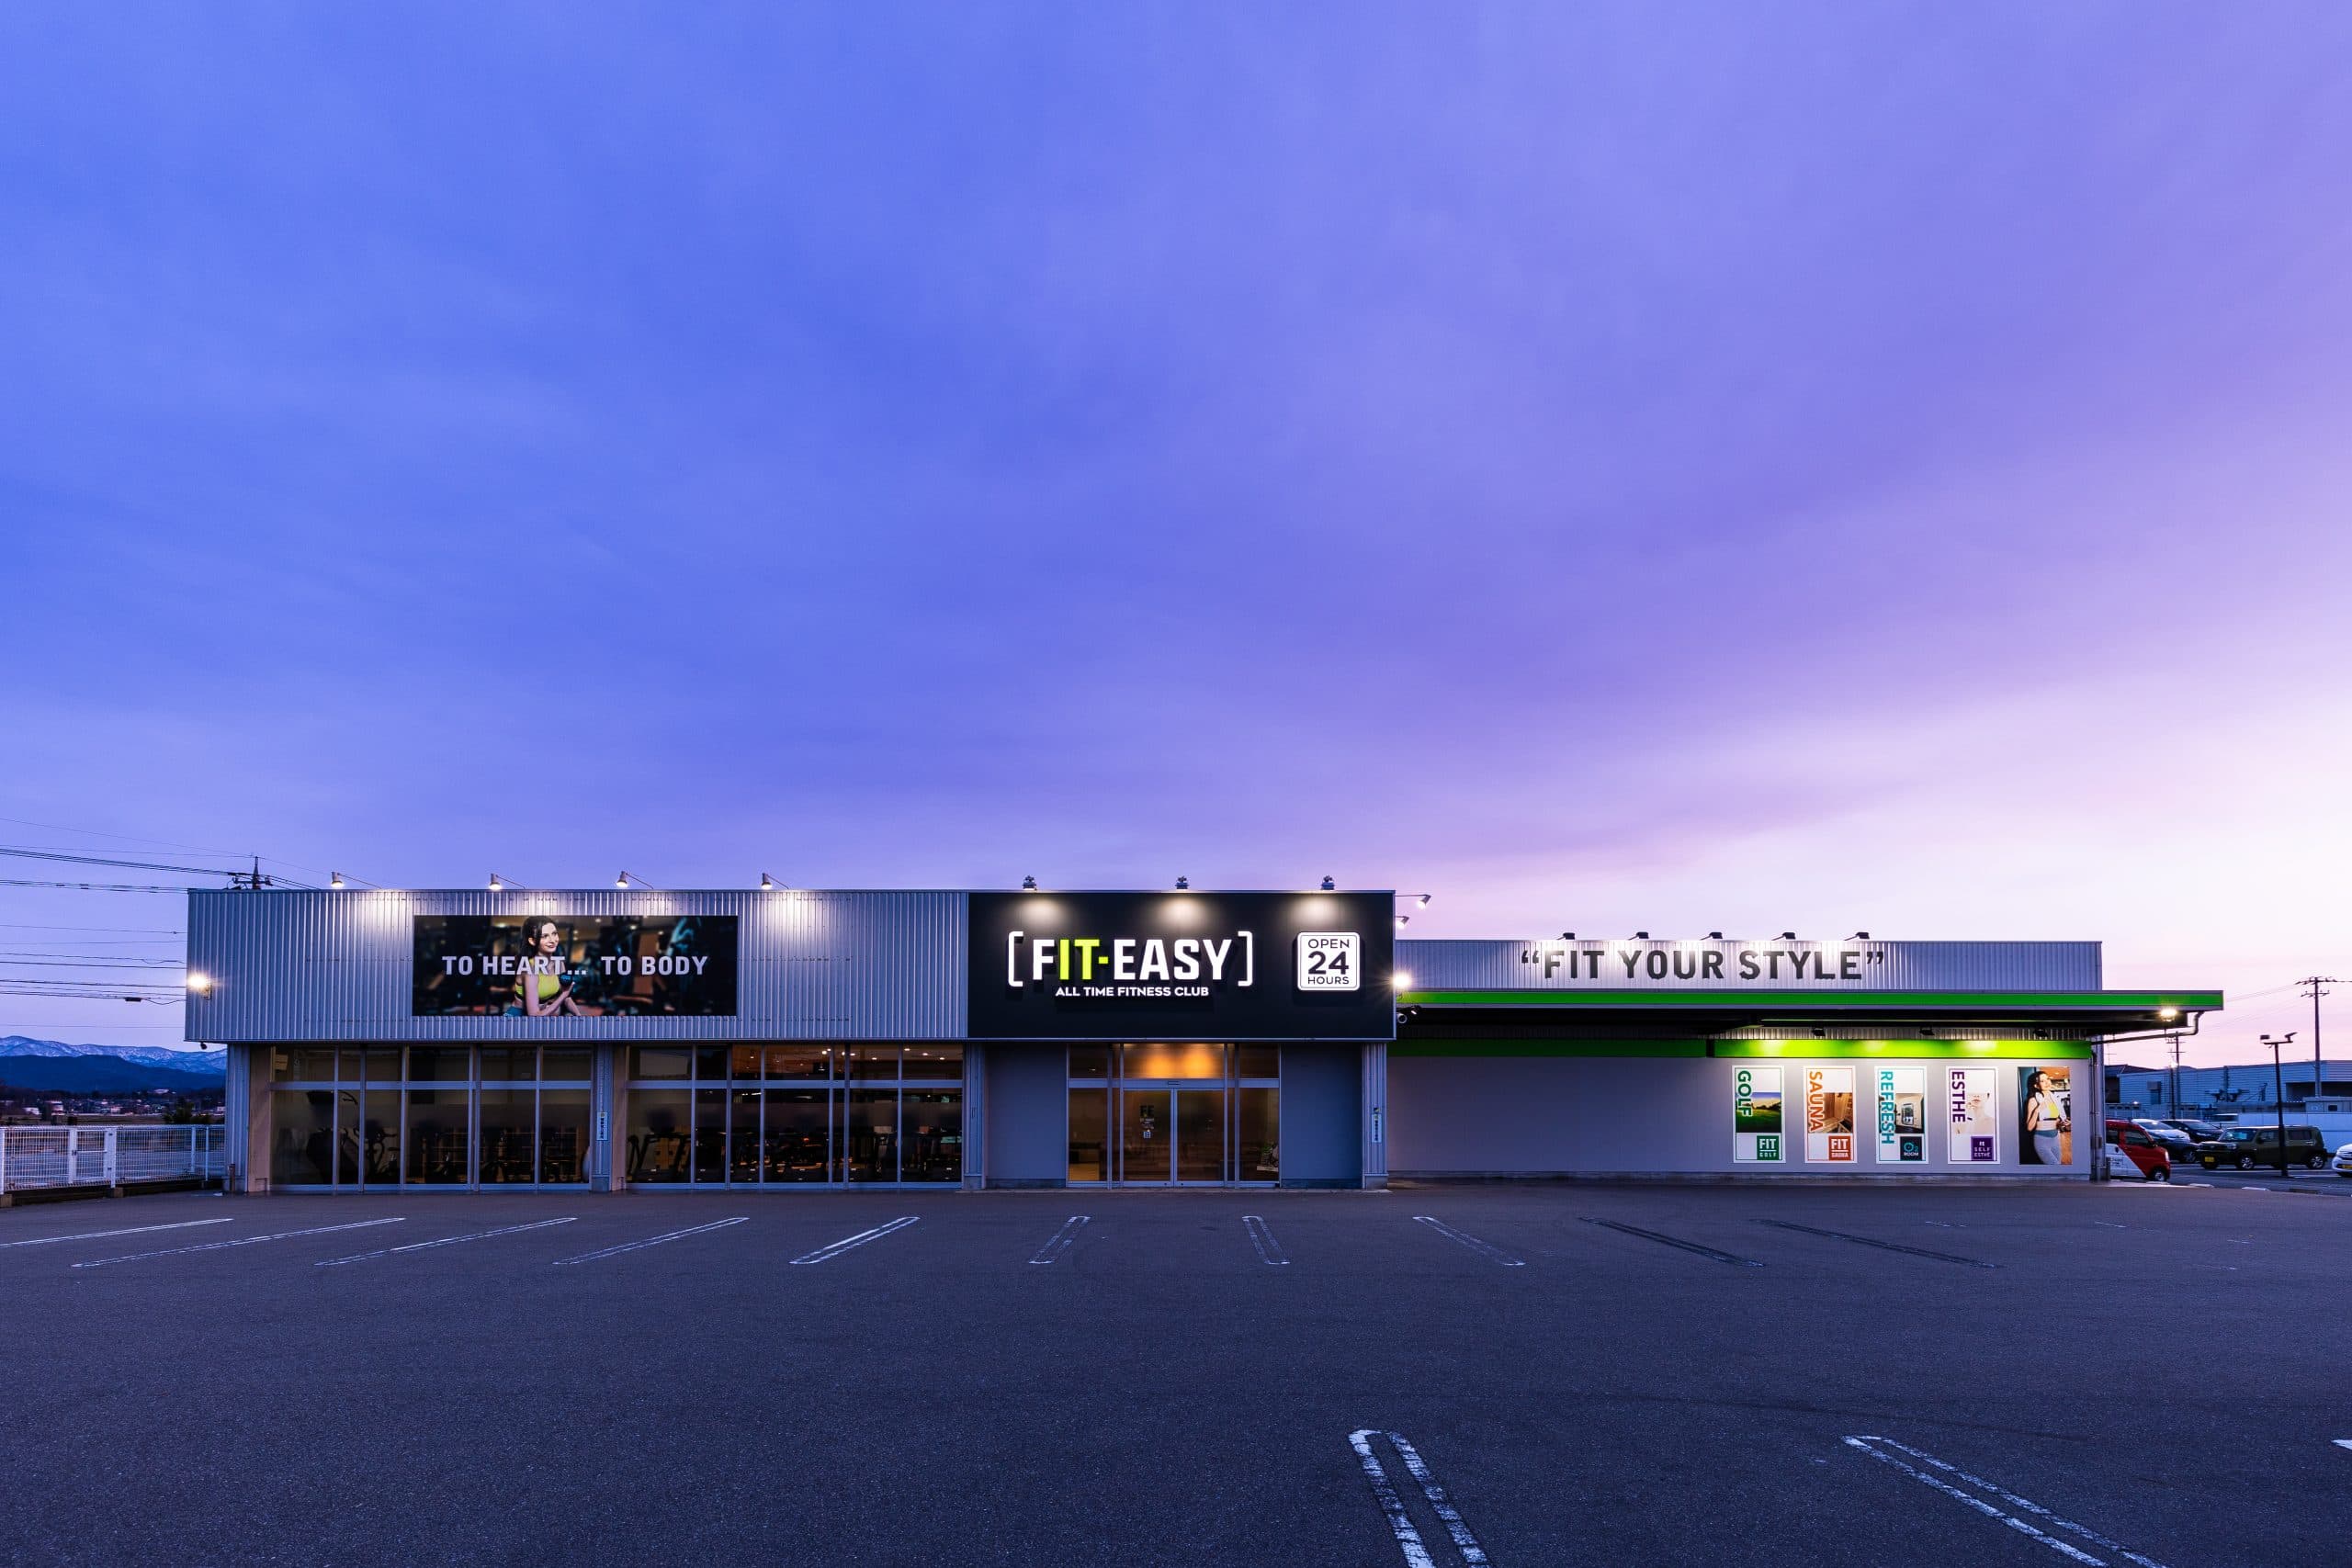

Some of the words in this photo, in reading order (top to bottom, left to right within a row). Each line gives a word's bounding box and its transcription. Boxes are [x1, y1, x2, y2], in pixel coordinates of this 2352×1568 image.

[1307, 938, 1350, 949] OPEN
[442, 955, 473, 976] TO
[482, 955, 586, 976] HEART...
[601, 955, 632, 976] TO
[641, 955, 708, 976] BODY
[1307, 950, 1350, 975] 24
[1617, 950, 1724, 980] YOUR
[1307, 976, 1350, 985] HOURS
[1055, 987, 1080, 997] ALL
[1083, 987, 1114, 997] TIME
[1117, 987, 1171, 997] FITNESS
[1174, 987, 1209, 997] CLUB
[1737, 1070, 1752, 1117] GOLF
[1809, 1071, 1824, 1131] SAUNA
[1880, 1070, 1895, 1145] REFRESH
[1758, 1138, 1777, 1149] FIT
[1831, 1138, 1849, 1149] FIT
